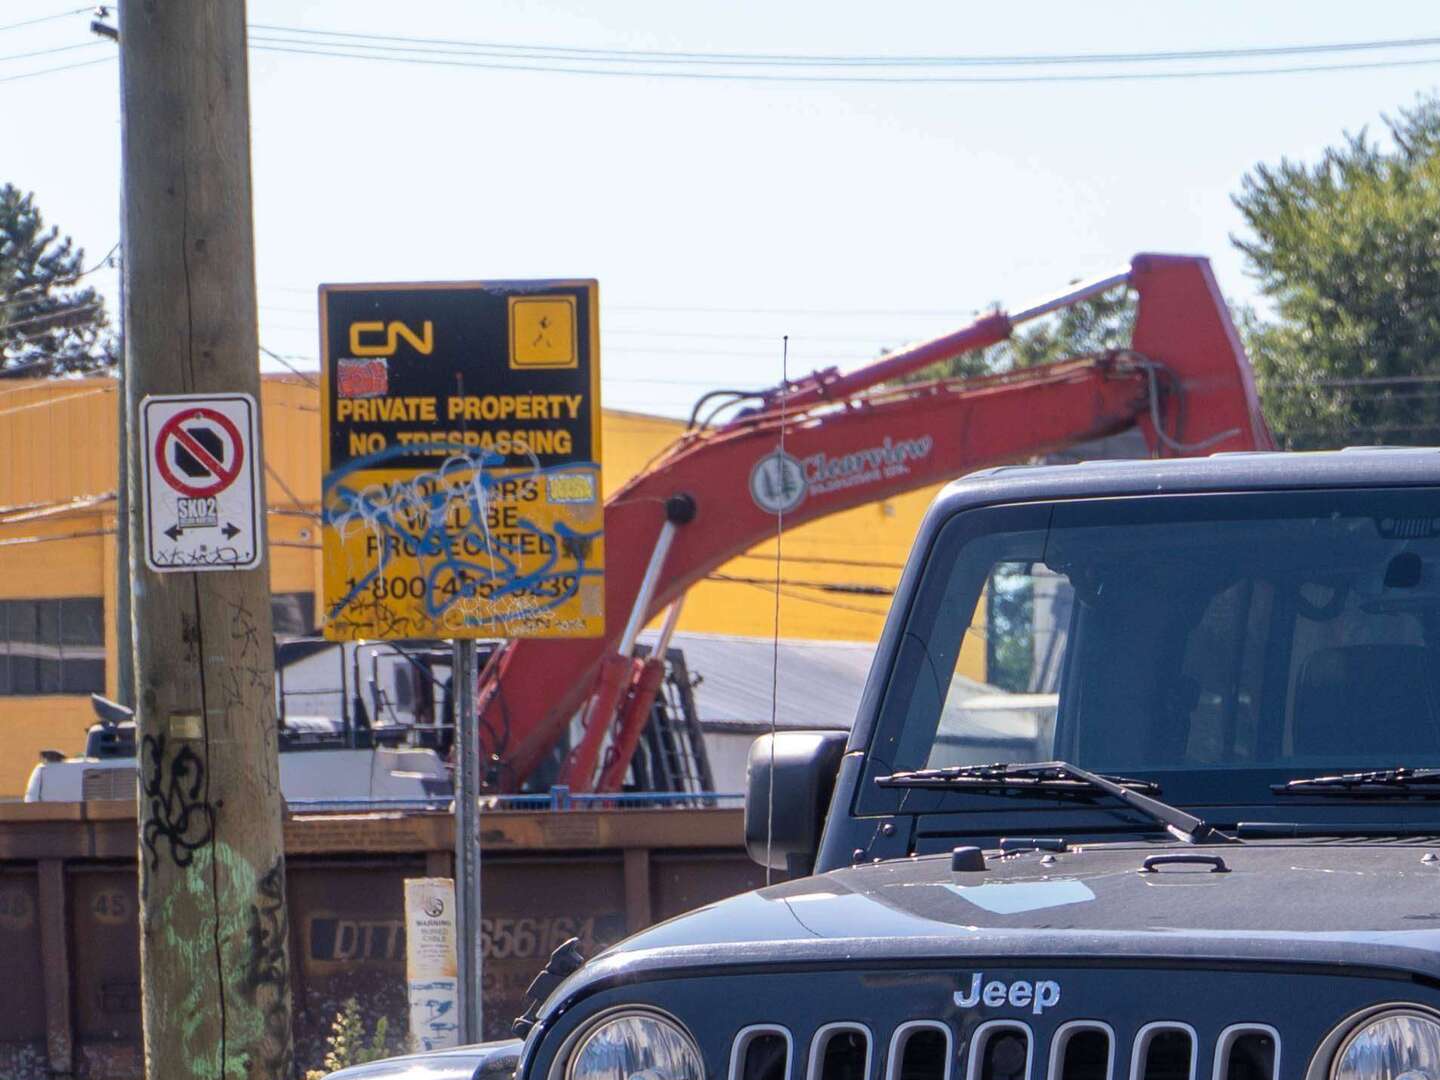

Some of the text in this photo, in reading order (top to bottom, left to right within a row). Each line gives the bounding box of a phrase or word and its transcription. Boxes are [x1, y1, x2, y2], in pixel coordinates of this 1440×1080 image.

[349, 320, 434, 357] CN
[337, 395, 583, 422] PRIVATE PROPERTY
[350, 430, 572, 456] NO TRESPASSING
[800, 436, 934, 484] Clearview
[383, 479, 539, 502] VOLATORS
[403, 506, 520, 530] WLL BE
[953, 972, 1061, 1015] Jeep
